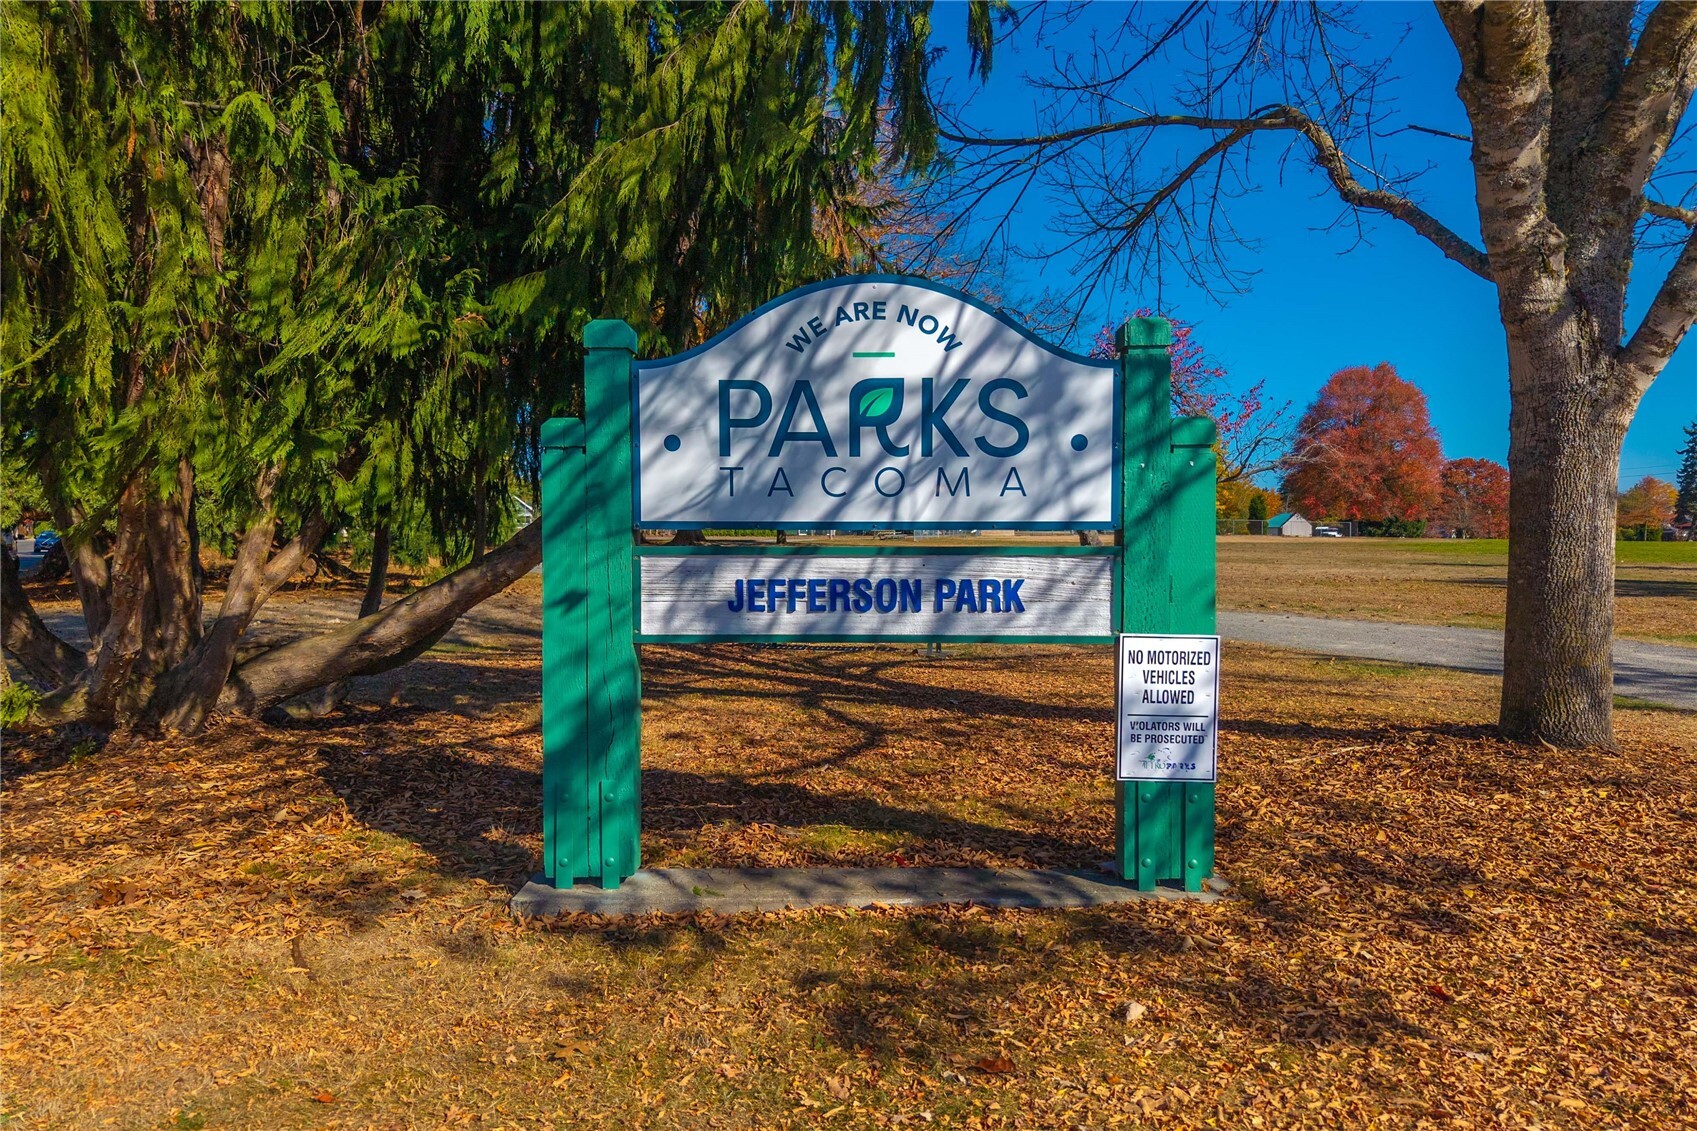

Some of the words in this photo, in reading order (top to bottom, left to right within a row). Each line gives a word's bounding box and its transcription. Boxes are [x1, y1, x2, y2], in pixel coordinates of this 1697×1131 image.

[784, 315, 828, 354] WE
[834, 301, 887, 326] ARE
[897, 304, 964, 353] NOW
[718, 376, 1030, 458] PARKS
[719, 466, 1028, 497] TACOMA
[727, 578, 922, 614] JEFFERSON
[935, 578, 1026, 614] PARK
[1128, 650, 1143, 664] NO
[1147, 650, 1211, 666] MOTORIZED
[1142, 670, 1195, 685] VEHICLES
[1142, 690, 1195, 705] ALLOWED
[1130, 721, 1180, 731] VIOLATORS
[1183, 722, 1205, 732] WILL
[1130, 734, 1142, 743] BE
[1144, 734, 1205, 744] PROSECUTED
